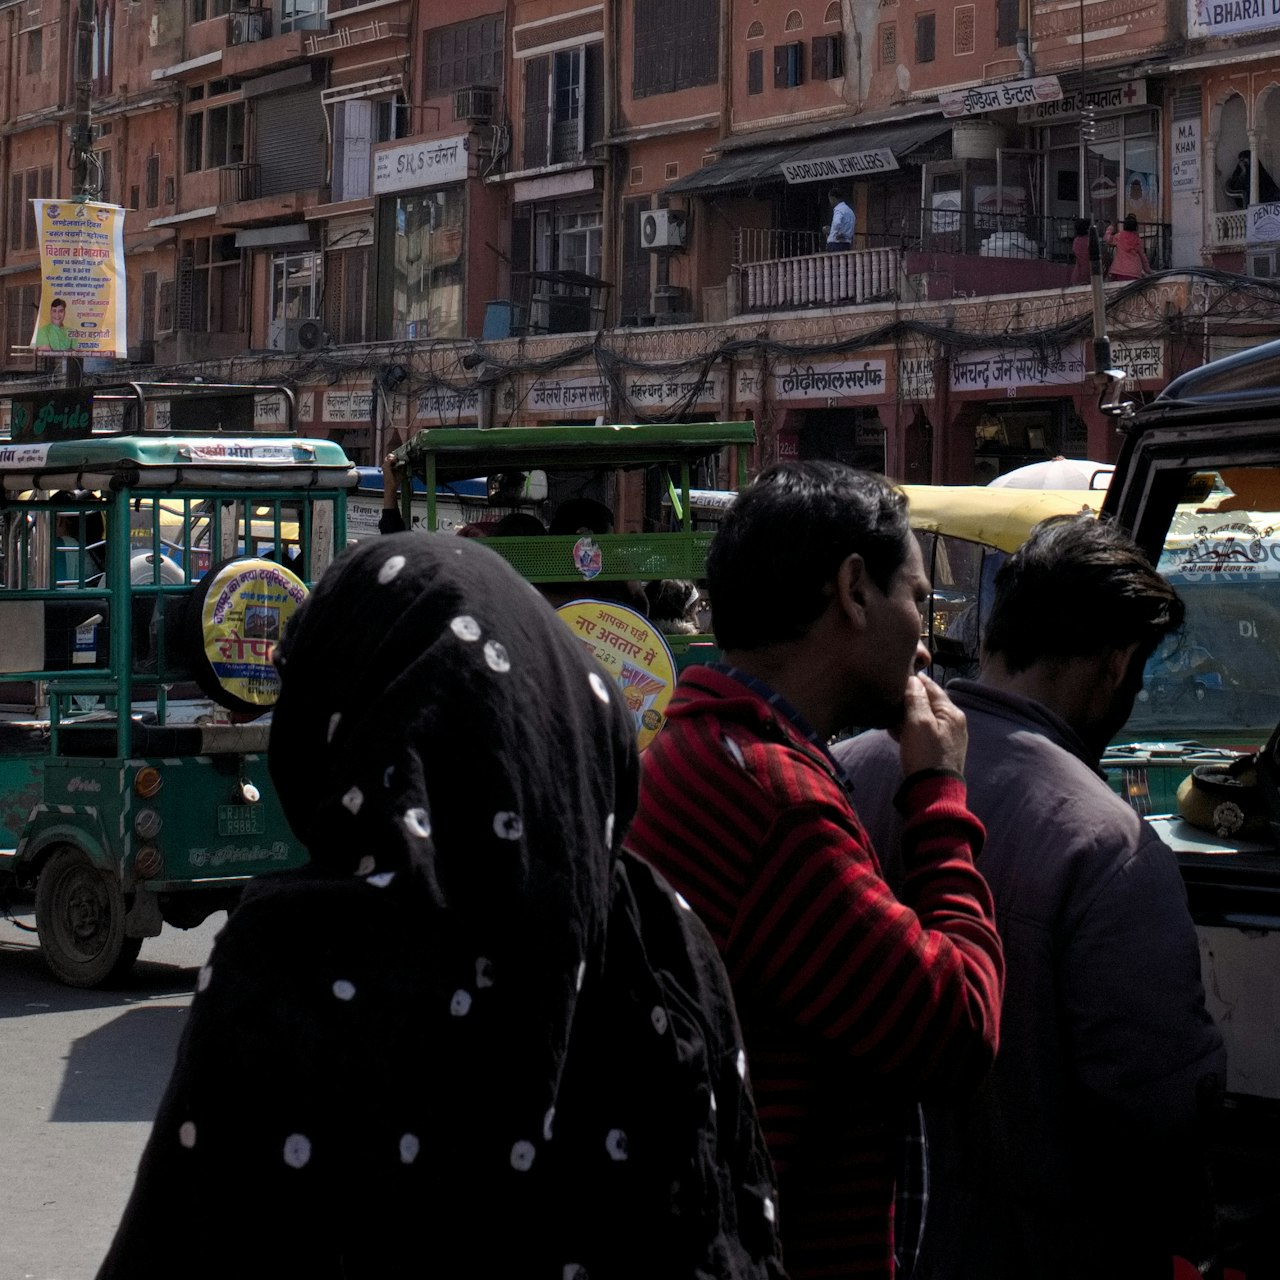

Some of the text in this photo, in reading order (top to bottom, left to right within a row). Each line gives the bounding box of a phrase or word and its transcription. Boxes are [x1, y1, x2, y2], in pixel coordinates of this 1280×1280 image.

[962, 84, 1036, 113] इण्डियन डेन्टल
[1179, 125, 1195, 138] M.A.
[1176, 140, 1195, 153] KHAN
[787, 153, 884, 180] SADRUDDIN JEWELLERS
[45, 245, 71, 257] विशाल
[67, 329, 87, 338] राकेश
[992, 354, 1013, 381] जैन
[1008, 387, 1016, 397] 20
[34, 402, 90, 435] Pride
[228, 443, 253, 458] भोग
[596, 610, 629, 632] आपका
[575, 615, 596, 635] नए
[596, 627, 643, 659] अवतार
[644, 647, 658, 666] में
[595, 649, 616, 665] 287
